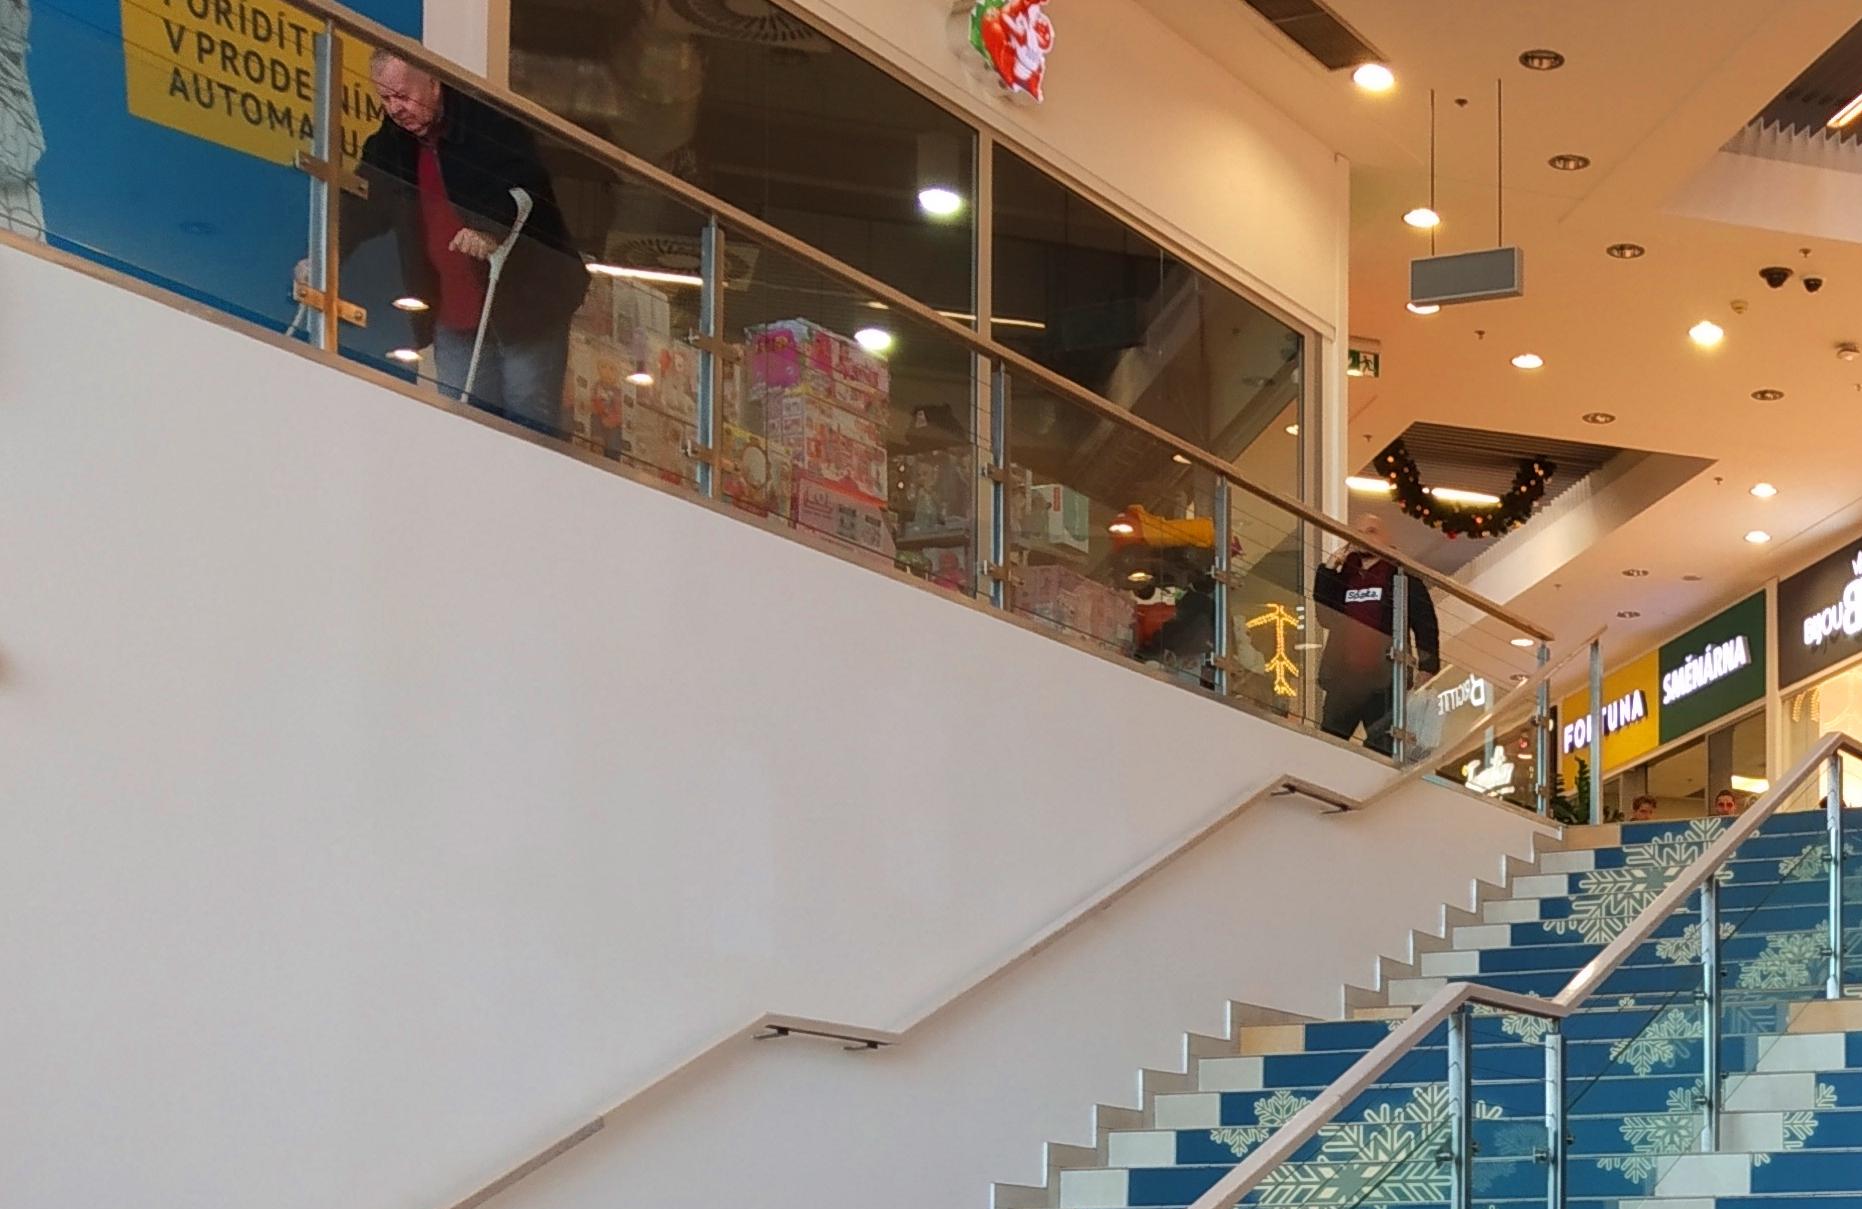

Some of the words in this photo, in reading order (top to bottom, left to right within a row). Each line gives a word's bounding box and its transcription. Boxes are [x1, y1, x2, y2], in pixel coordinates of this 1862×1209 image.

[164, 19, 186, 54] V
[169, 66, 358, 159] AUTOMAU
[1804, 602, 1843, 645] BIJOU
[1663, 636, 1746, 704] SMĚNÁRNA
